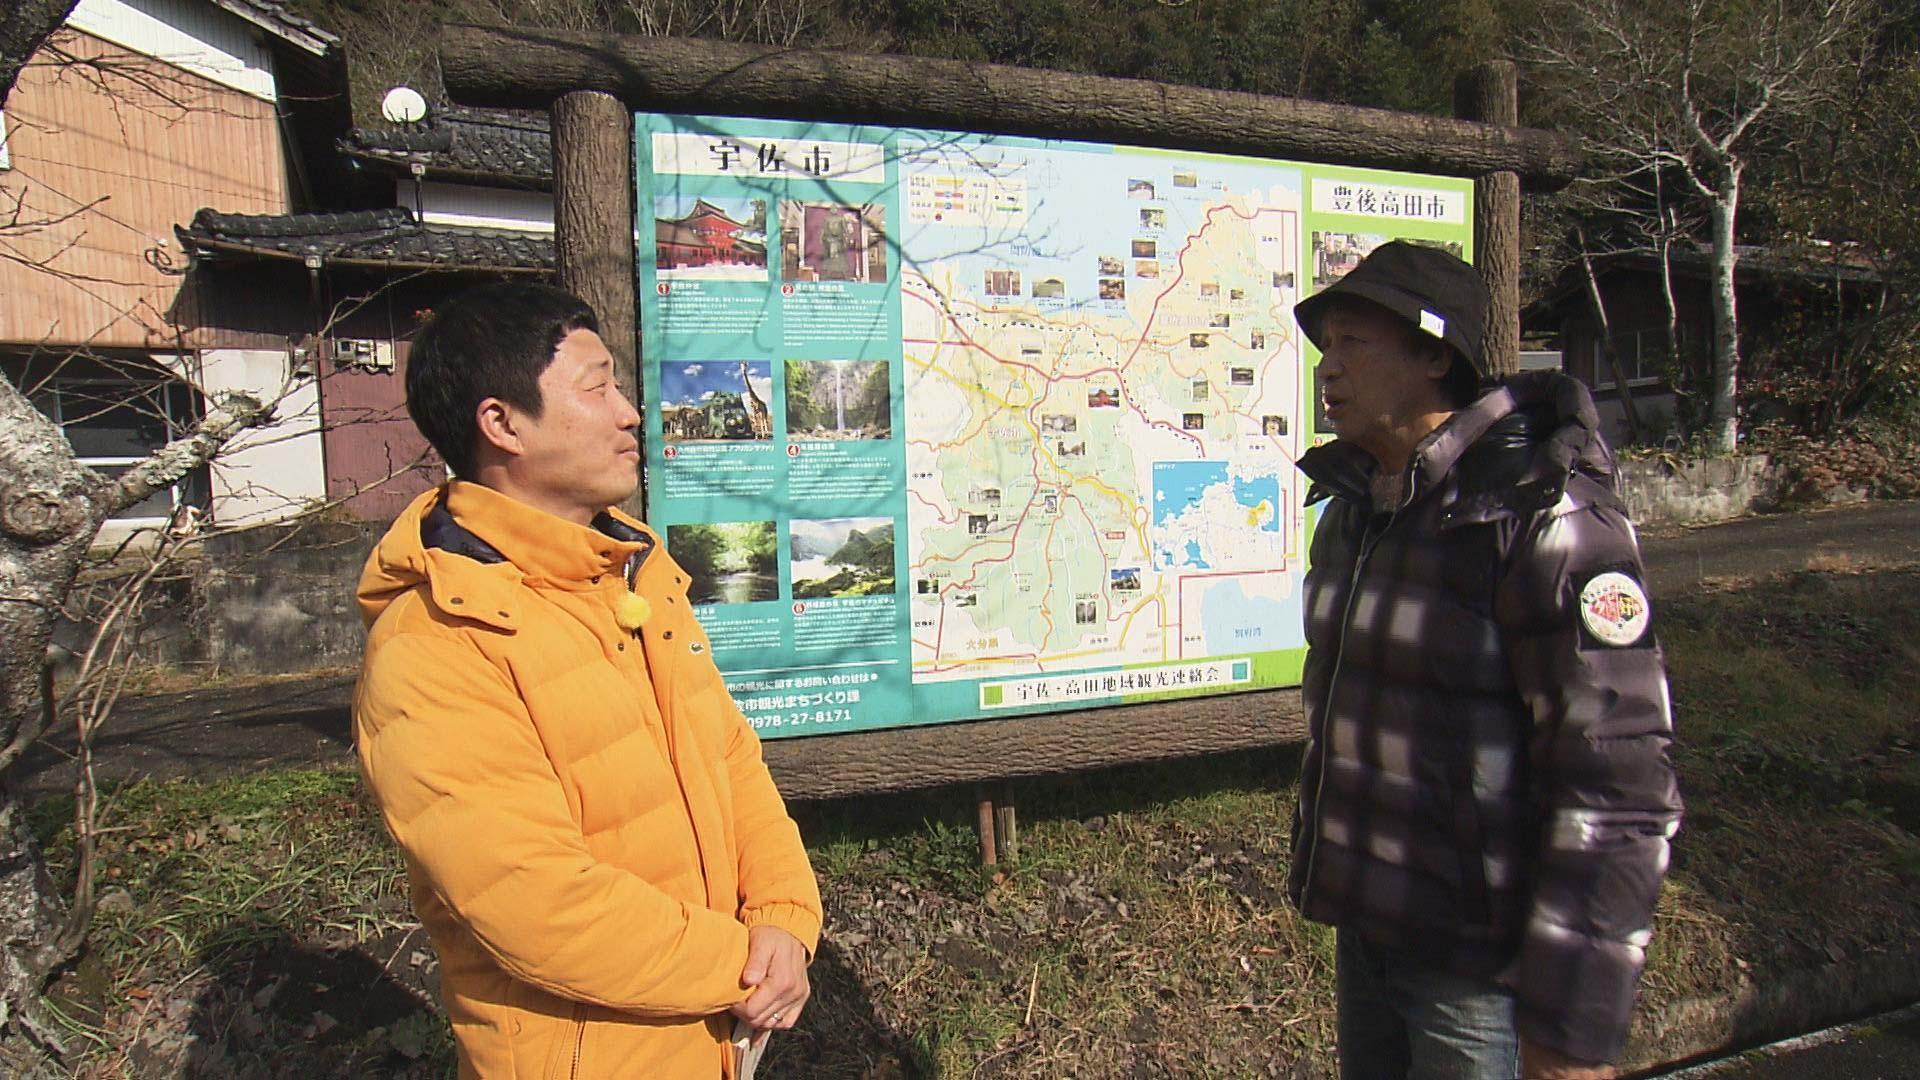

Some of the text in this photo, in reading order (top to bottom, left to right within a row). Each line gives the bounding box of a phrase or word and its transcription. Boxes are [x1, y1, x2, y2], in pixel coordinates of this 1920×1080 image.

[709, 140, 832, 176] 宇佐市
[1332, 185, 1446, 218] 豊後高田市
